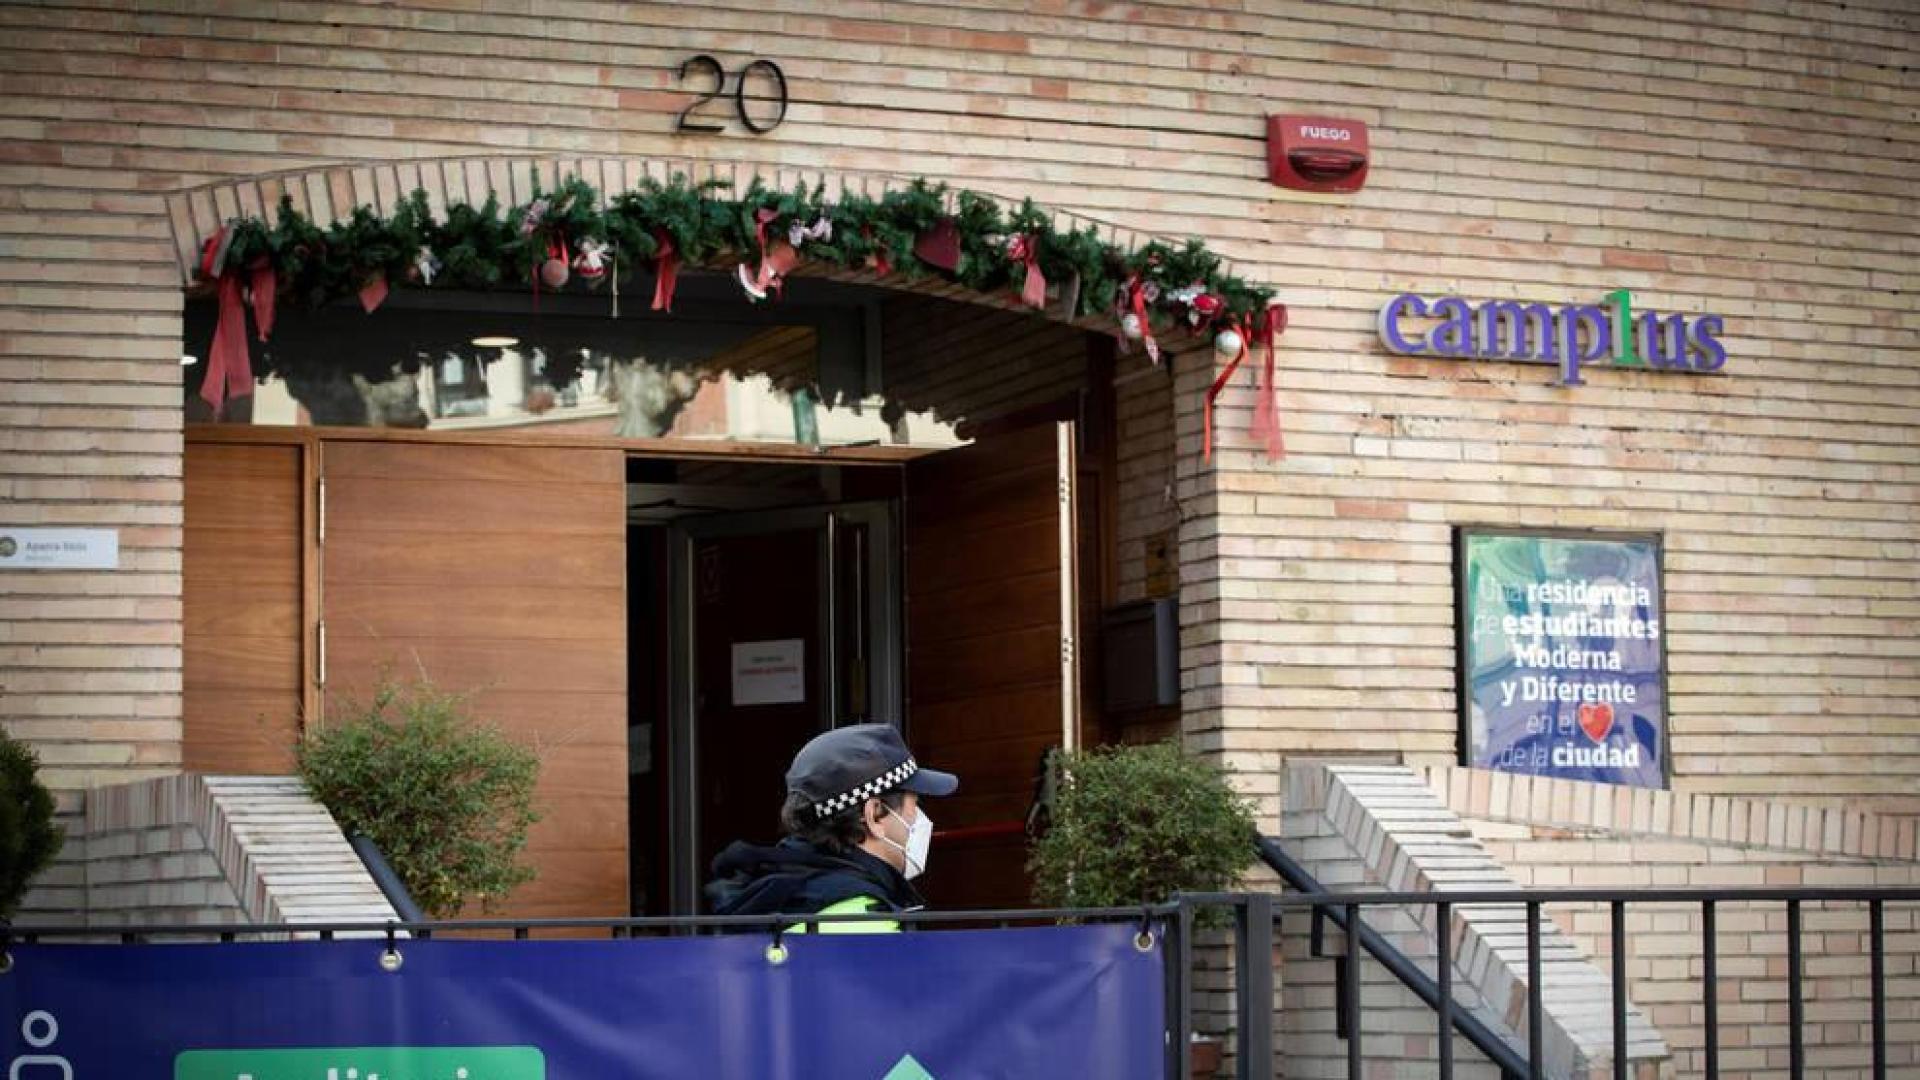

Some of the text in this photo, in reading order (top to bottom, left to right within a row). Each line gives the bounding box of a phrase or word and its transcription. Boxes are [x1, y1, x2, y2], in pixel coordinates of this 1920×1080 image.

[680, 55, 788, 134] 20
[1300, 125, 1351, 140] FUEGO
[1380, 288, 1727, 385] camplus
[1527, 579, 1651, 606] residencia
[1502, 610, 1659, 638] estudiantes
[1514, 643, 1622, 670] Moderna
[1500, 676, 1636, 706] y Diferente
[1526, 711, 1576, 737] en el
[1500, 743, 1526, 766] de
[1552, 741, 1640, 768] ciudad
